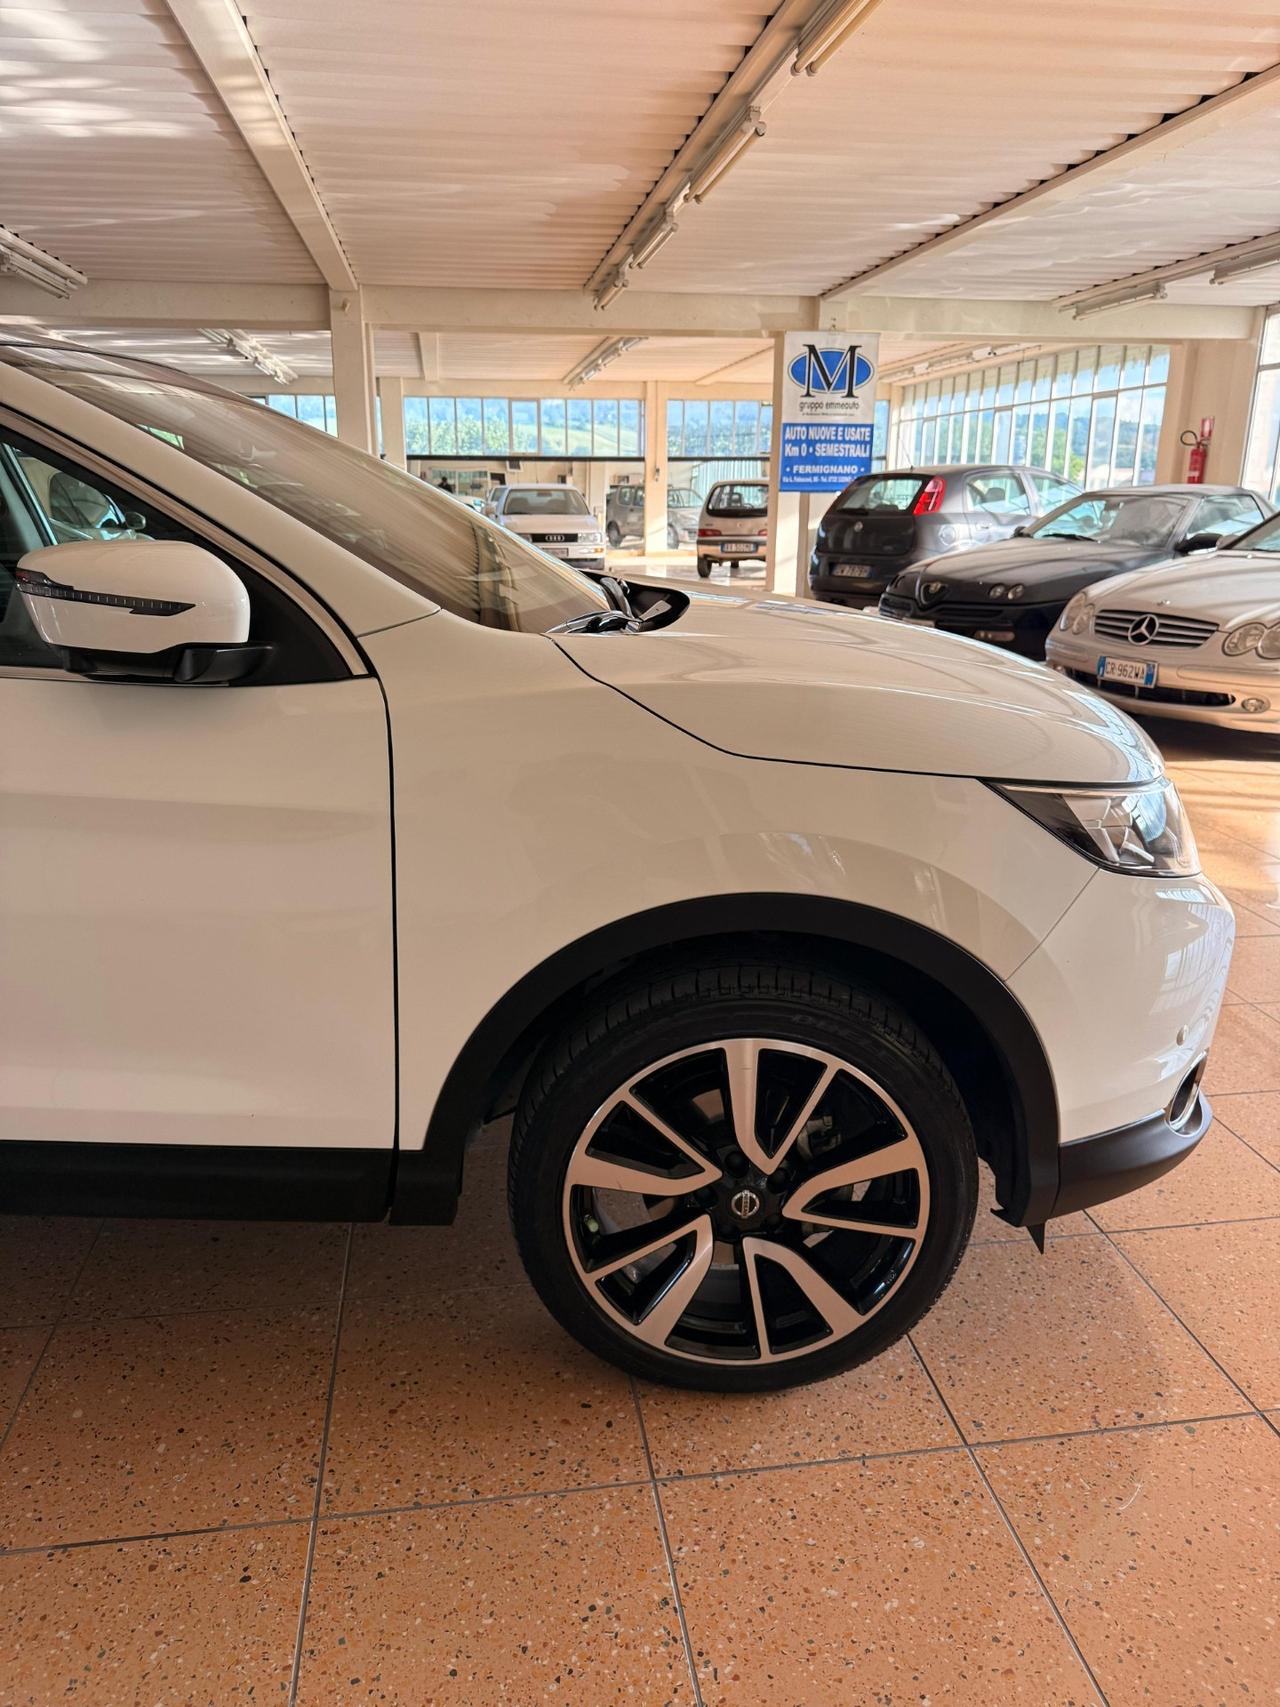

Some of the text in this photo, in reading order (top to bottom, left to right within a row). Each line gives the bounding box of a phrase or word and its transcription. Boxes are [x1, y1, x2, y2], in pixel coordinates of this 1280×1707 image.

[800, 344, 862, 398] M
[799, 401, 824, 412] gruppo
[785, 426, 871, 441] AUTO NUOVE E USATE
[784, 443, 799, 457] Km
[814, 443, 870, 458] SEMESTRALI
[792, 464, 859, 474] FERMIGNANO
